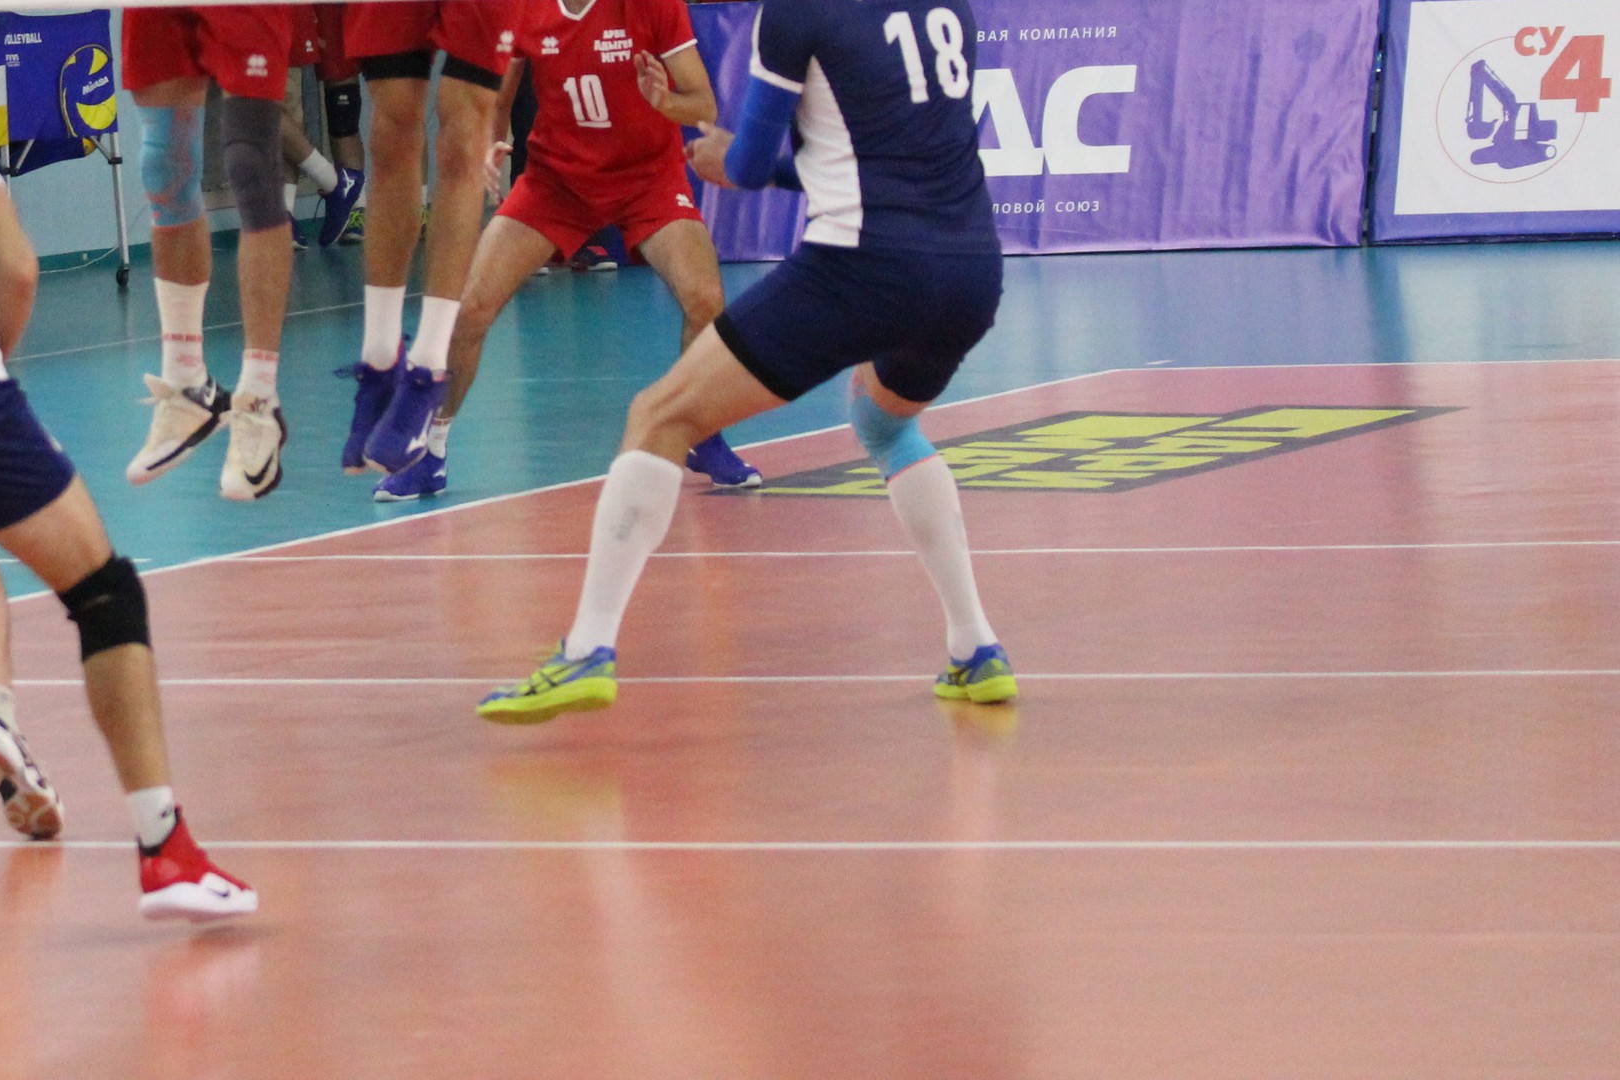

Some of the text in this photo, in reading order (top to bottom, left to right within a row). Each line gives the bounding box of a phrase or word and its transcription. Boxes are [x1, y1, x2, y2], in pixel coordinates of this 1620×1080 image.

[883, 7, 970, 104] 18
[977, 26, 1117, 43] ВАЯ КОМПАНИЯ
[563, 74, 611, 123] 10
[1540, 34, 1612, 113] 4
[971, 64, 1137, 177] ДС
[992, 200, 1100, 214] ЛОВОЙ СОЮЗ
